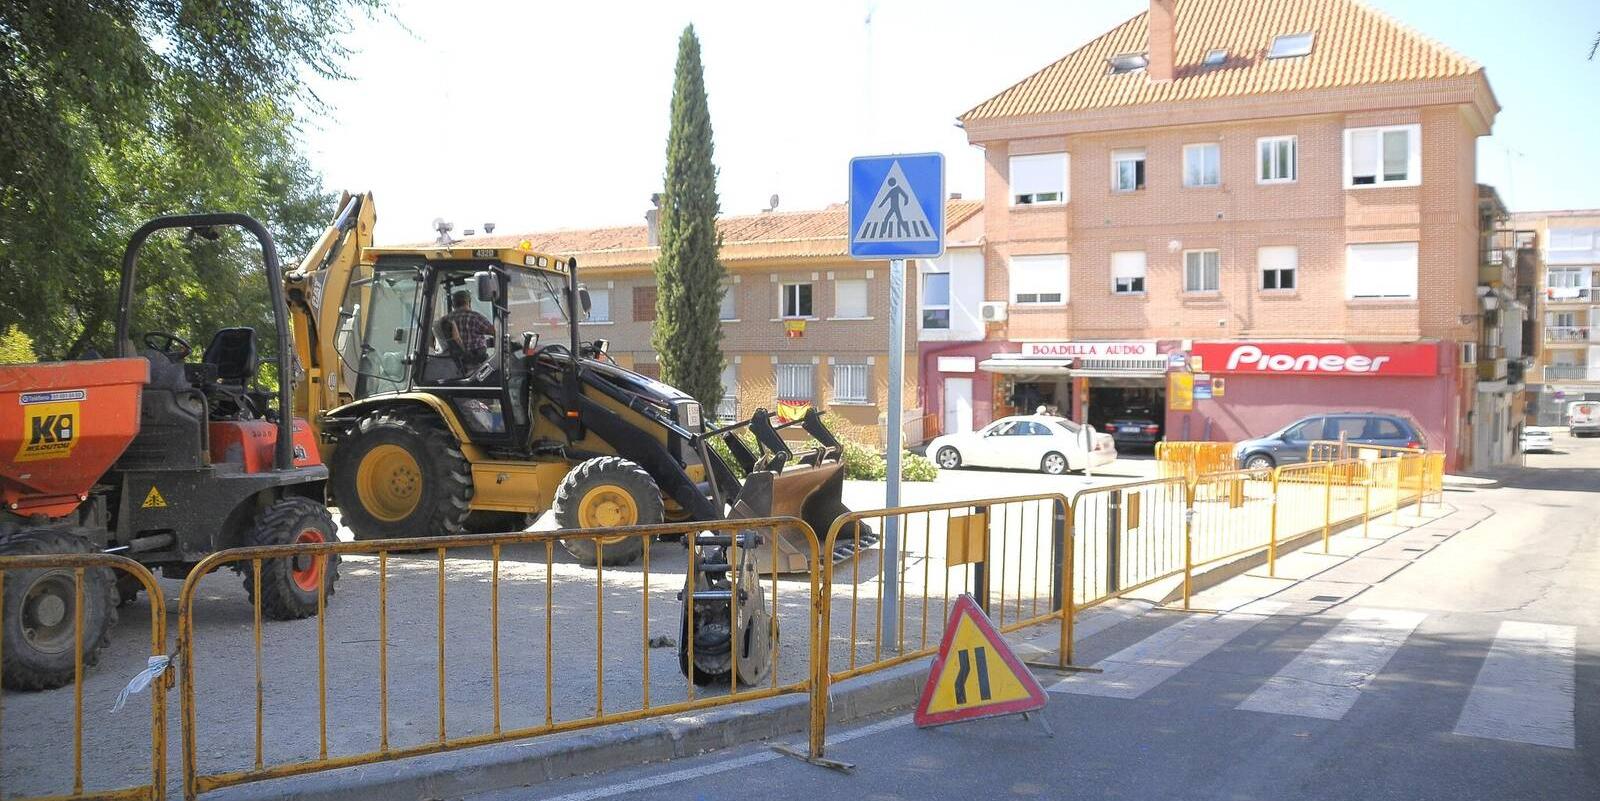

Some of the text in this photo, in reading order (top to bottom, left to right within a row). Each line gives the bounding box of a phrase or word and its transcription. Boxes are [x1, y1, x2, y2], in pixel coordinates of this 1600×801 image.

[1032, 345, 1145, 355] BOADILLA AUDIO
[1226, 345, 1390, 372] Pioneer
